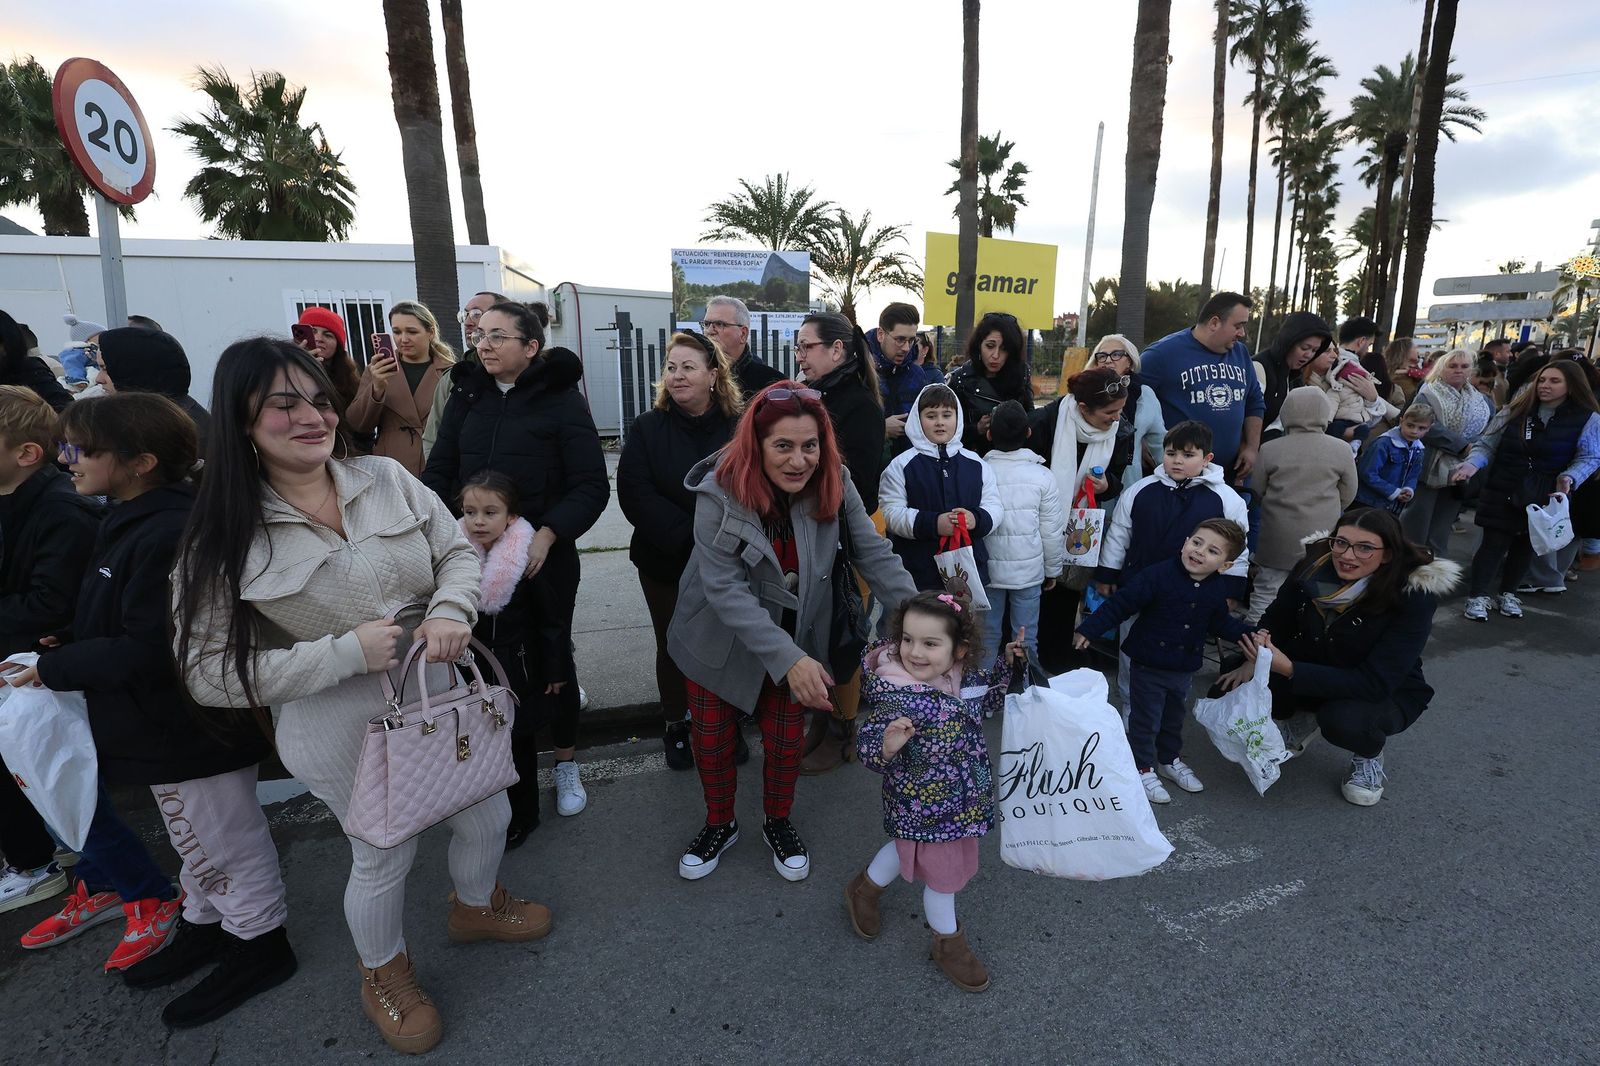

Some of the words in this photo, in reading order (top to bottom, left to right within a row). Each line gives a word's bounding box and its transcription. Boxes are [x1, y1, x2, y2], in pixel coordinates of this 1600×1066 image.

[84, 101, 138, 164] 20
[945, 271, 1039, 295] gamar
[998, 731, 1104, 802] Flash
